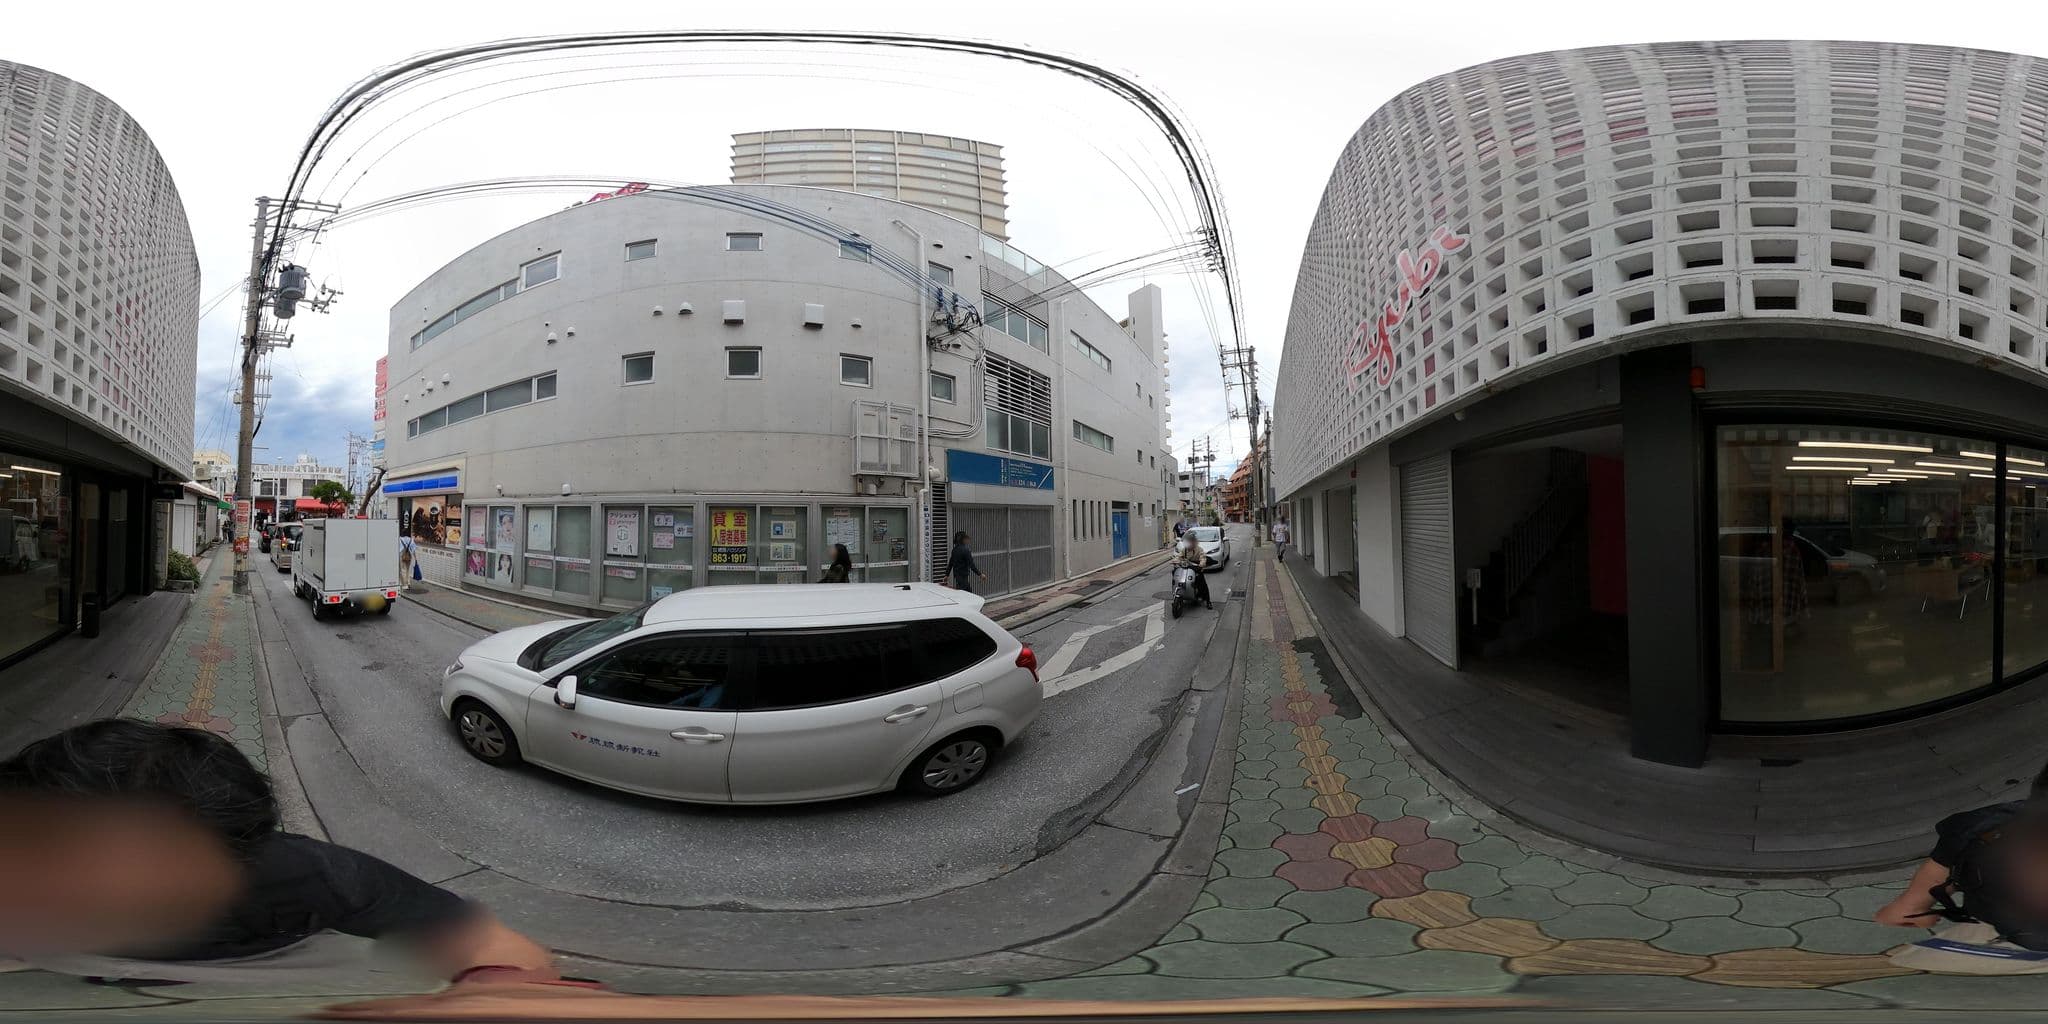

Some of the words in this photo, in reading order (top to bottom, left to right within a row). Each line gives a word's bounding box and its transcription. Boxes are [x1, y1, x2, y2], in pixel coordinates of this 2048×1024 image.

[712, 529, 747, 545] 入居者募集
